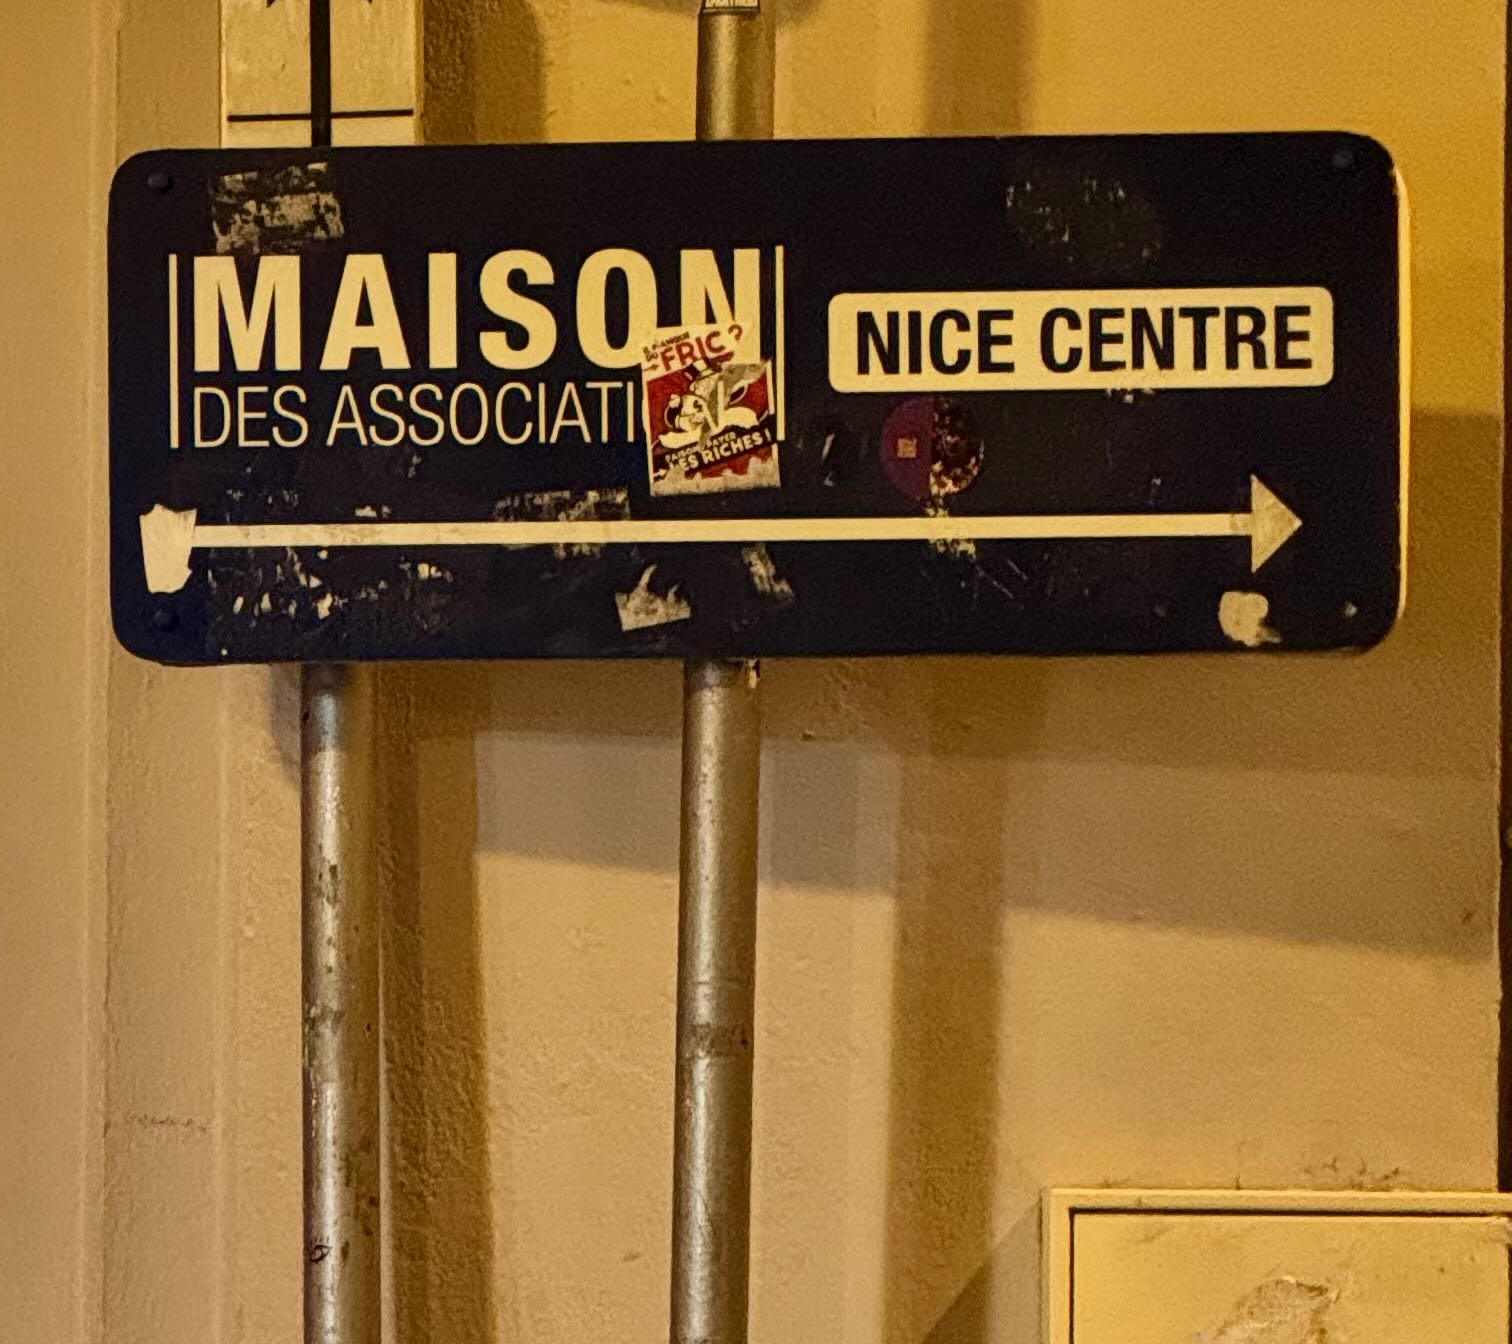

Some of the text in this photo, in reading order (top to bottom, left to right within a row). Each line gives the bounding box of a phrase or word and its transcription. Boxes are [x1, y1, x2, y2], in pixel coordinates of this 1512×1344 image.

[193, 248, 761, 372] MAISON
[856, 304, 1313, 376] NICE CENTRE
[659, 330, 726, 372] FRIC
[727, 324, 743, 342] ?
[194, 380, 648, 449] DES ASSOCIATI
[701, 431, 764, 465] RICHES
